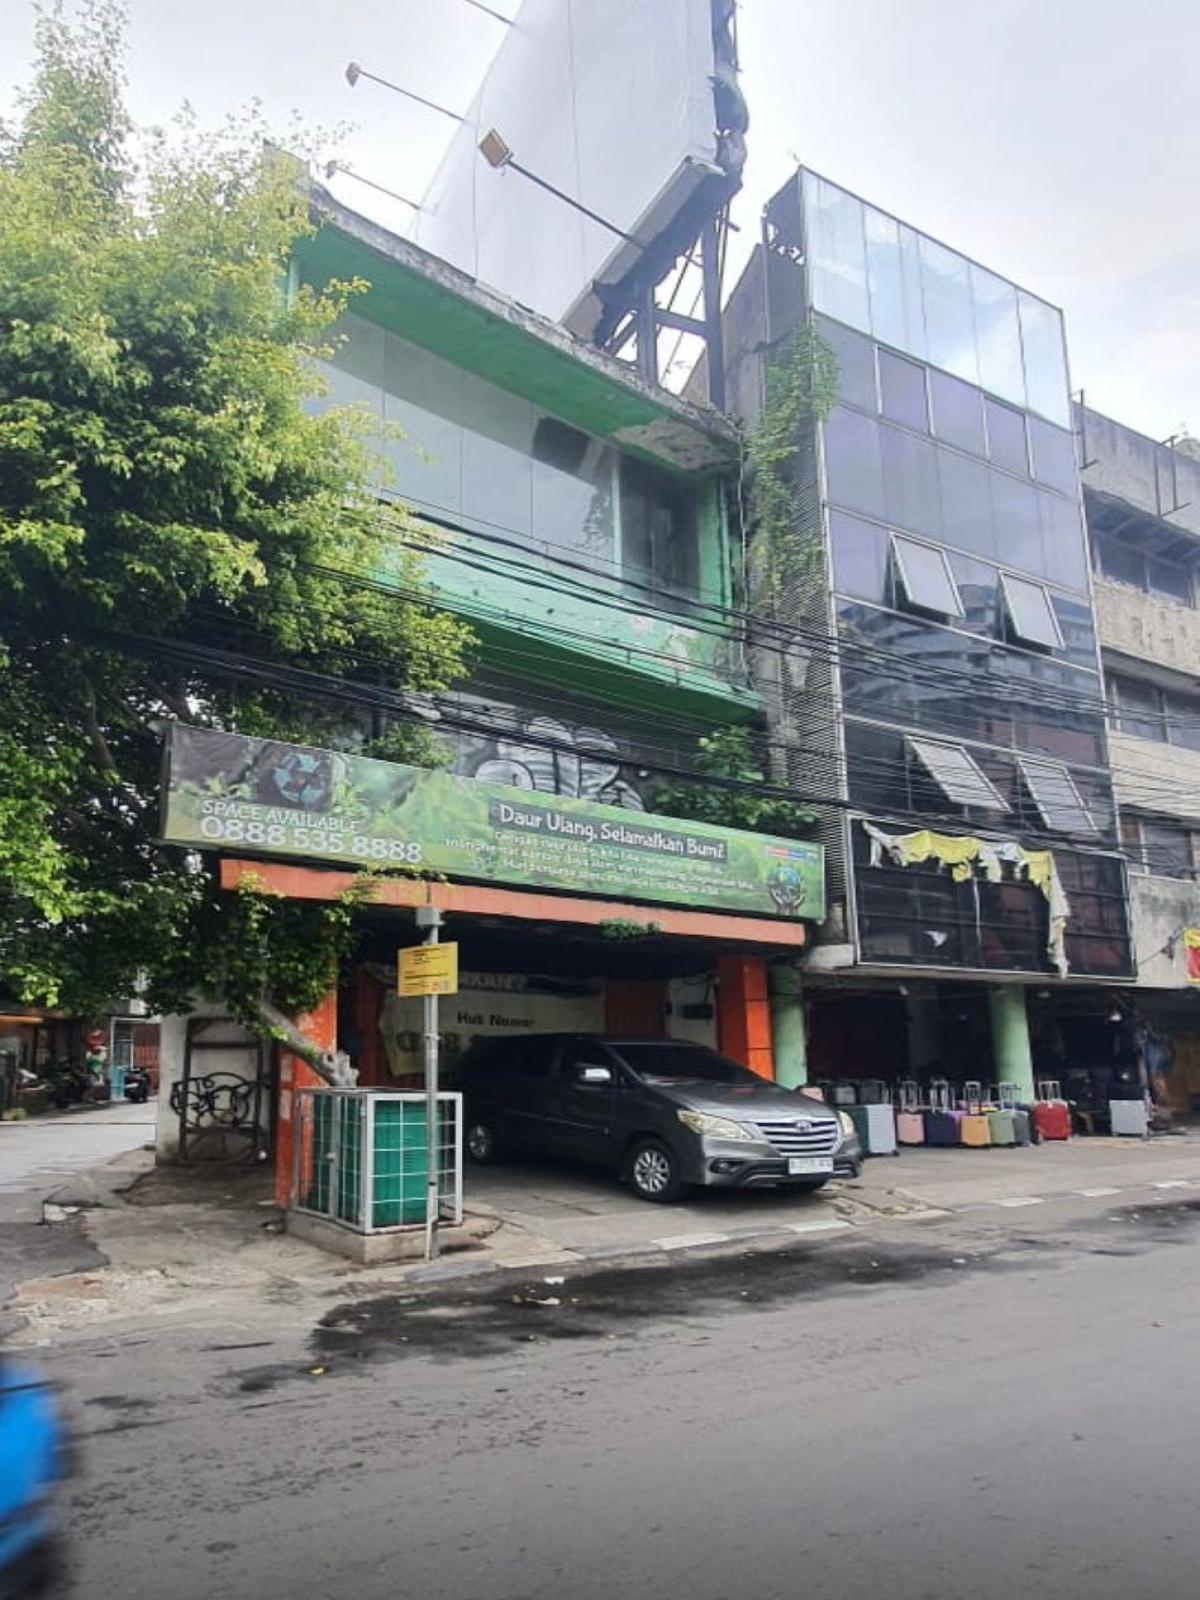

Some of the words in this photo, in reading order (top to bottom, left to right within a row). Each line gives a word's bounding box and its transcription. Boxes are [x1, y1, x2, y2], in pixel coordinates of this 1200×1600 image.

[202, 800, 261, 821] SPACE
[266, 807, 360, 833] AVAILABLE
[500, 804, 544, 828] Daur
[201, 816, 286, 847] 0888
[293, 829, 344, 853] 535
[351, 836, 423, 863] 8888
